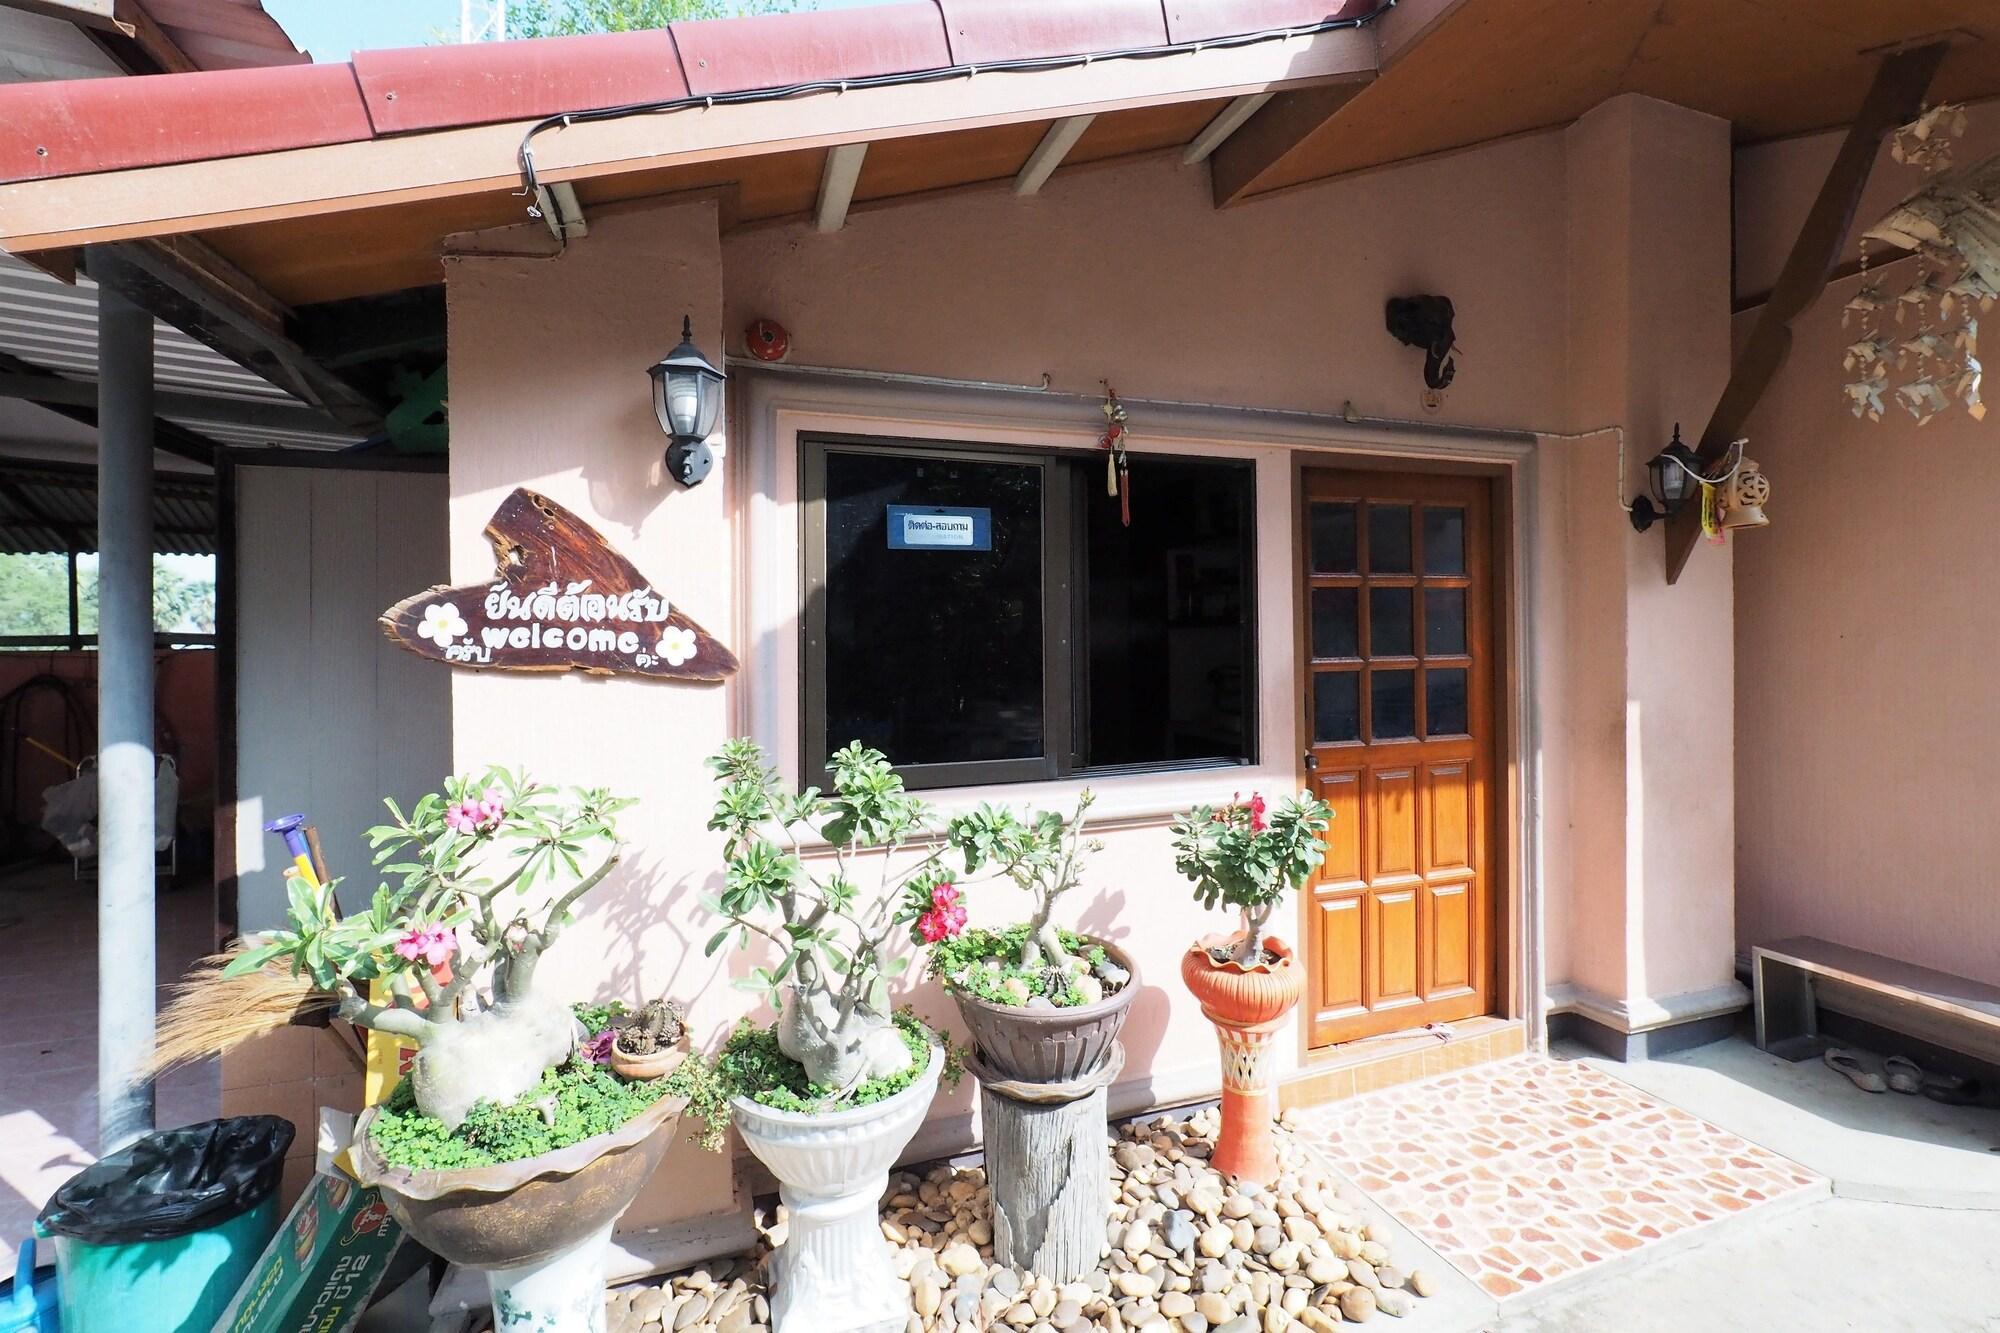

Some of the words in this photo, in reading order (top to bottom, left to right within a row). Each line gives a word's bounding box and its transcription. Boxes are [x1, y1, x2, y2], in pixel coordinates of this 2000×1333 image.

[907, 519, 969, 531] ติดต่อ-สอบถาม
[484, 579, 670, 622] ยินดีต้อนรับ
[445, 637, 491, 662] ครับ
[481, 622, 639, 653] welcome
[635, 647, 659, 668] ค่ะ
